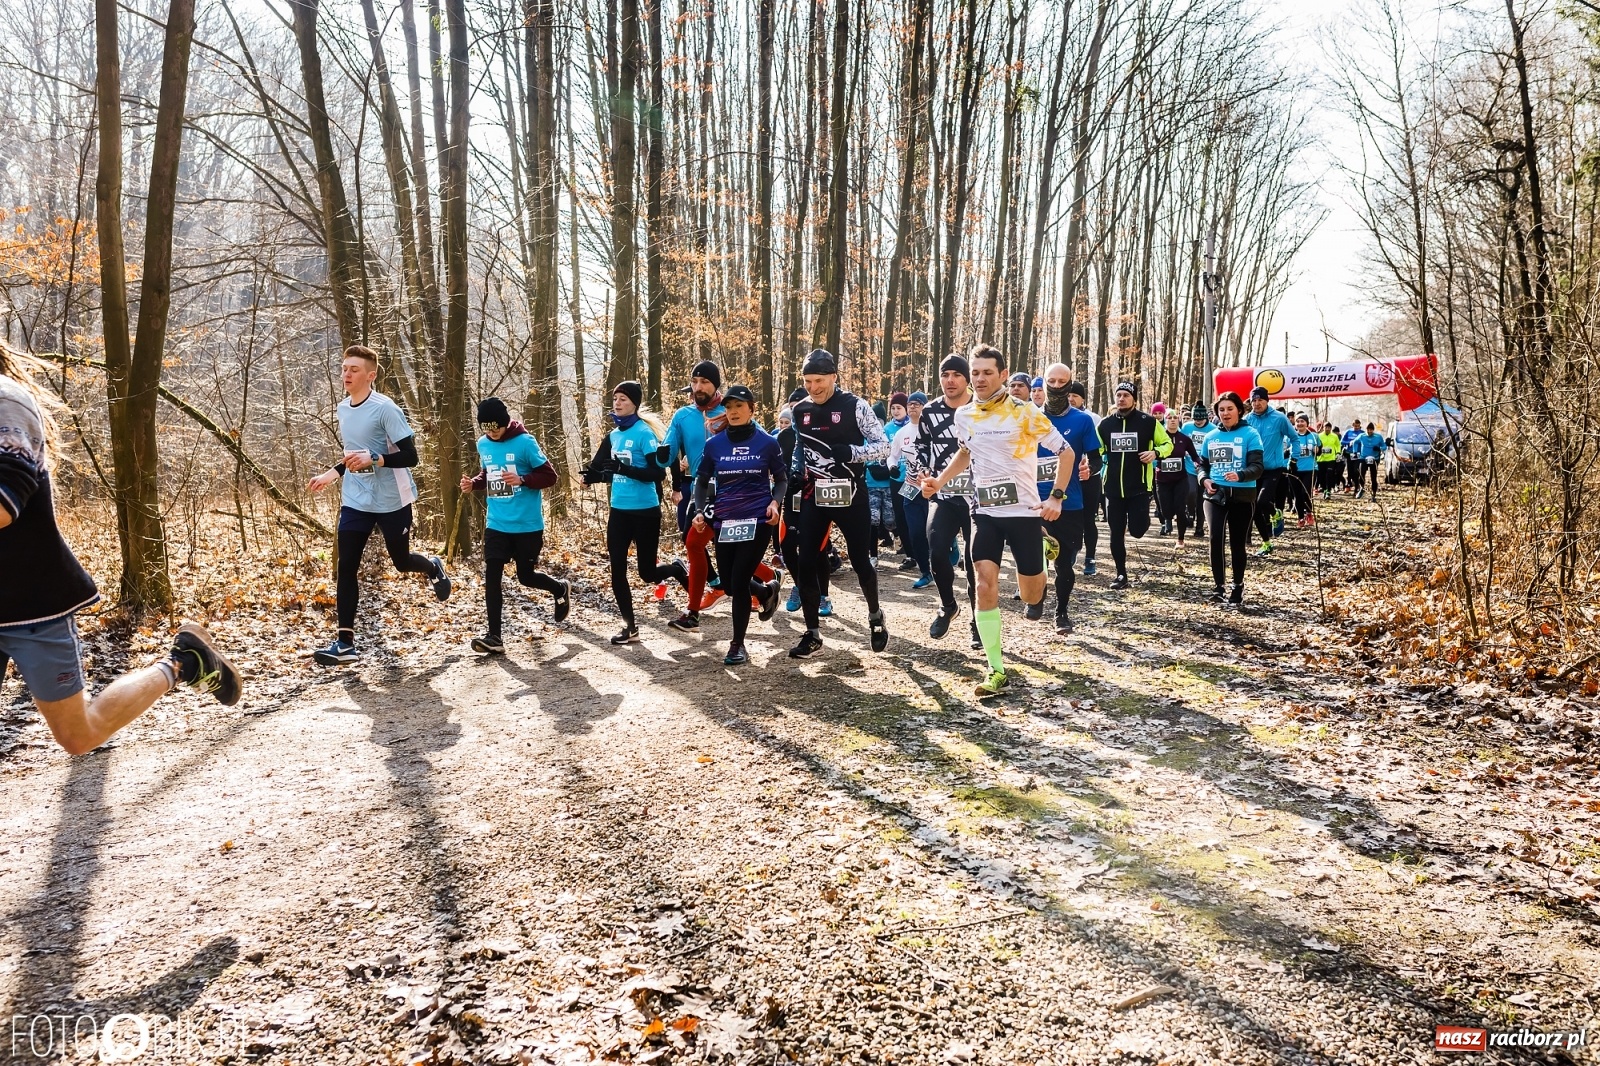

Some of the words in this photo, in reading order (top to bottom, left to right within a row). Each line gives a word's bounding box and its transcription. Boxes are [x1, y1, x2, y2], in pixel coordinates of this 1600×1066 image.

[1311, 365, 1336, 373] BIEG
[1291, 373, 1357, 384] TWARDZIELA
[1298, 384, 1350, 394] RACIBÓRZ
[1212, 449, 1226, 458] 126
[490, 481, 506, 490] 007
[947, 478, 969, 488] 047
[821, 488, 843, 499] 081
[985, 487, 1008, 500] 162
[727, 526, 749, 536] 063
